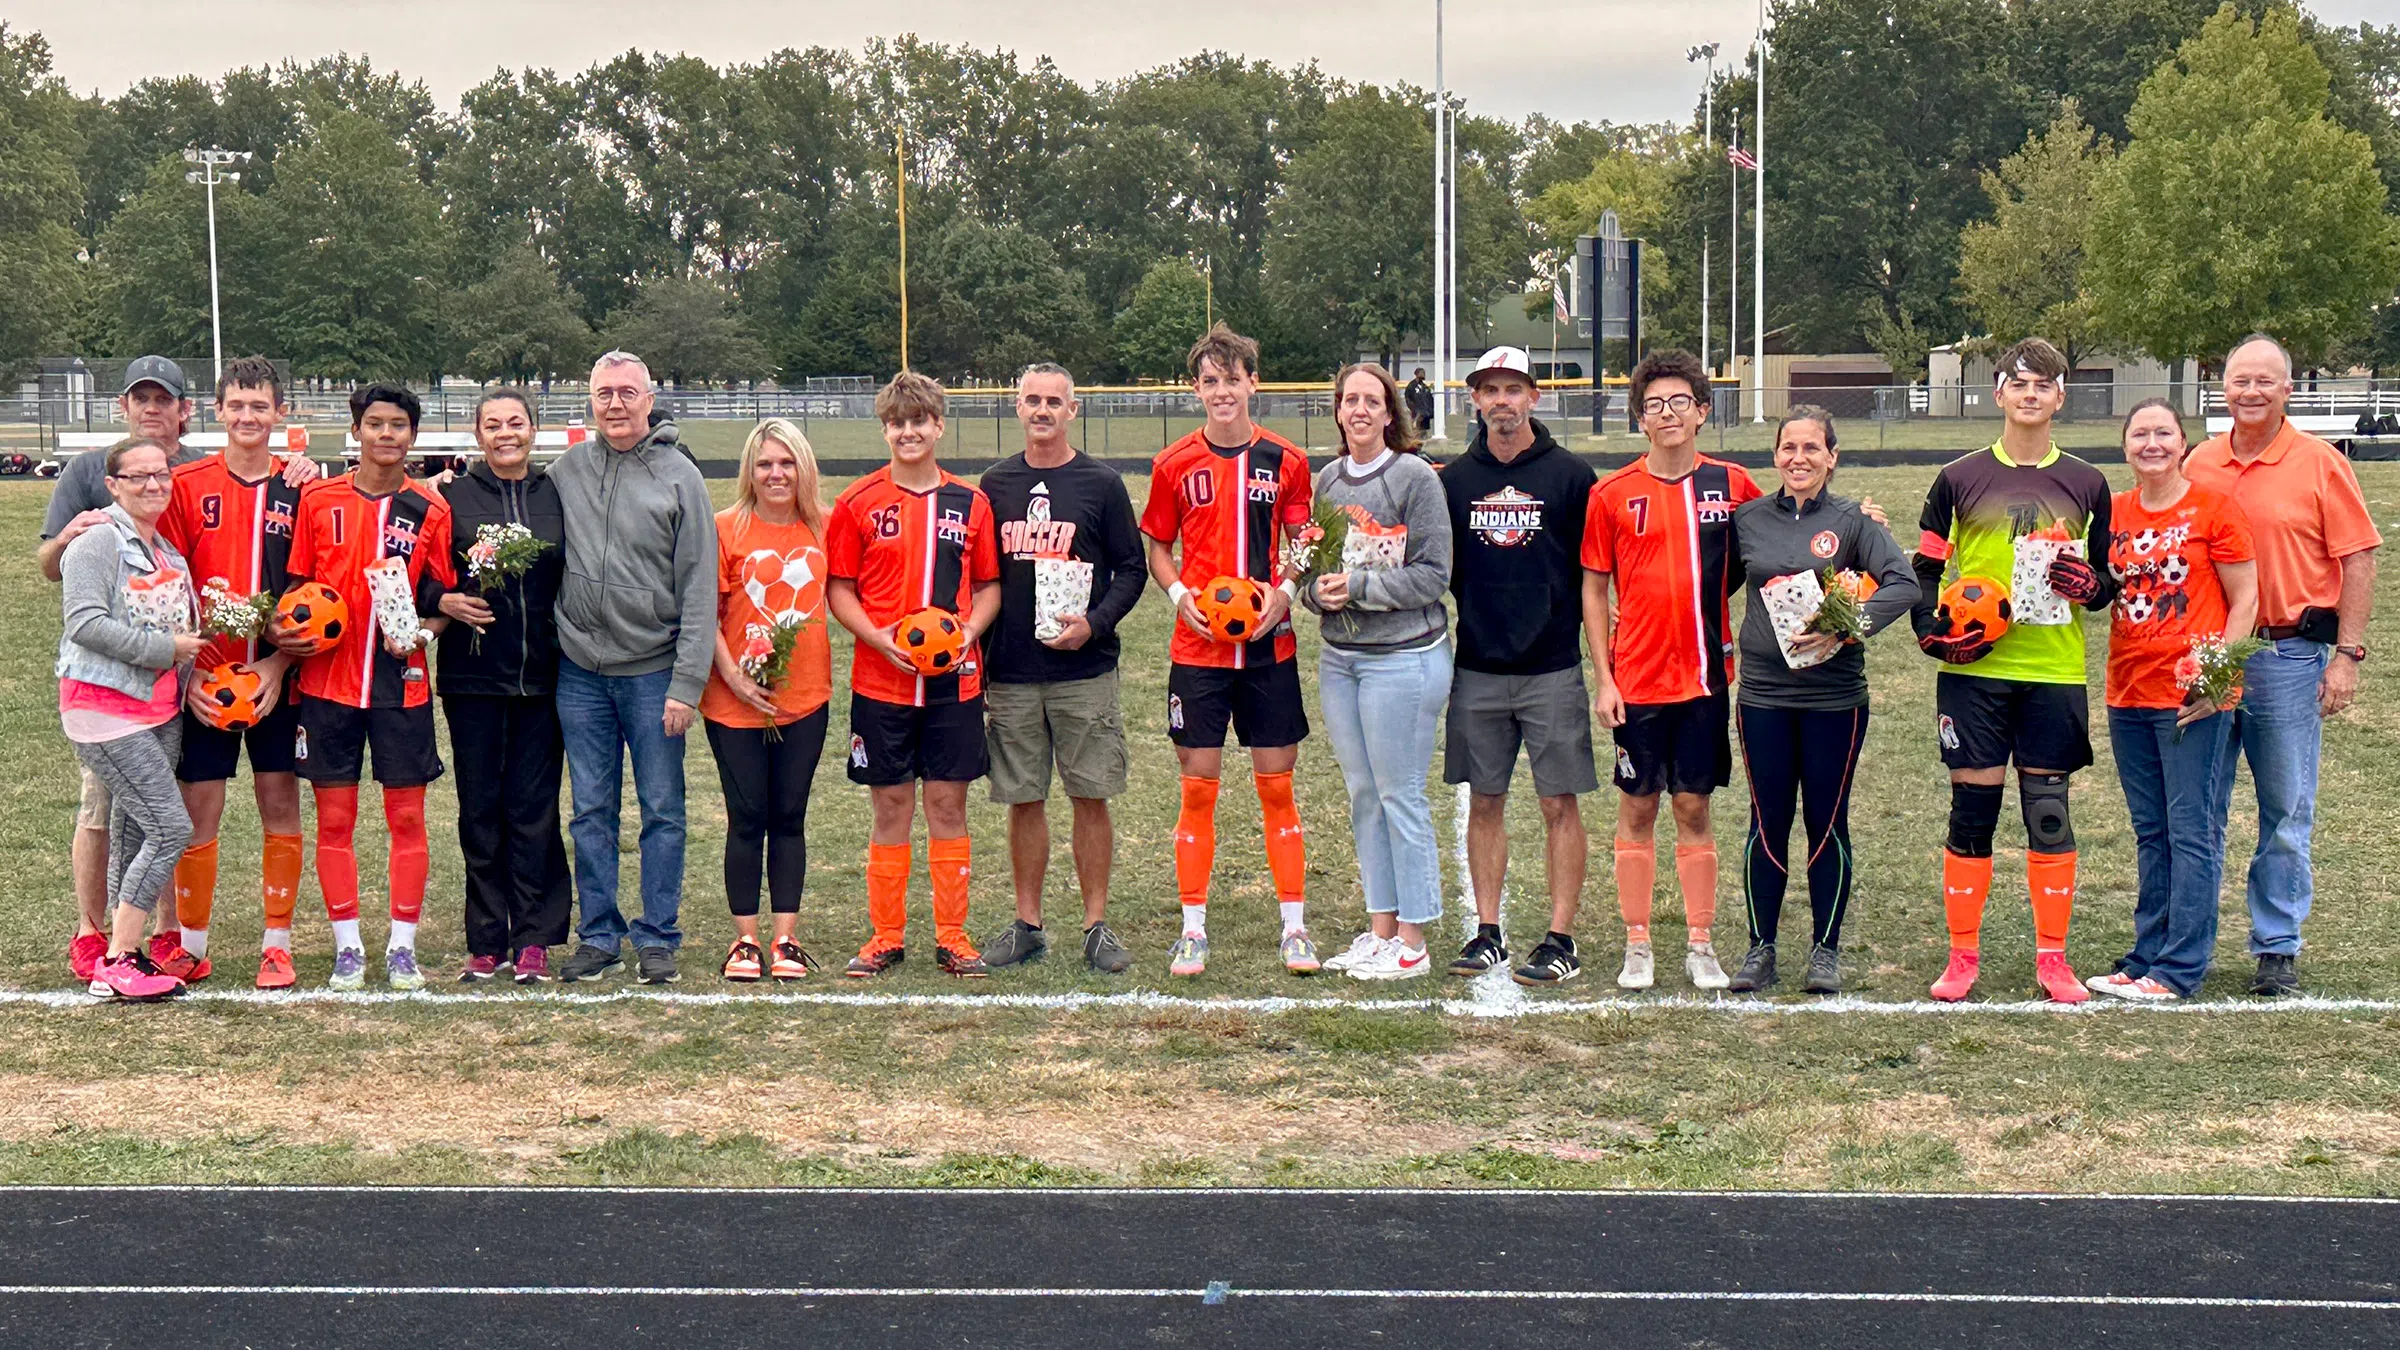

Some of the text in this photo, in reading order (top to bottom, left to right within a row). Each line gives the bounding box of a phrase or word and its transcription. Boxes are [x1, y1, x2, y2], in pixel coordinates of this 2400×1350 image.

[1181, 468, 1215, 509] 10
[201, 493, 222, 530] 9
[330, 506, 344, 545] 1
[869, 503, 901, 540] 16
[1470, 510, 1541, 526] INDIANS
[1626, 495, 1650, 536] 7
[1001, 520, 1076, 554] SOCCER
